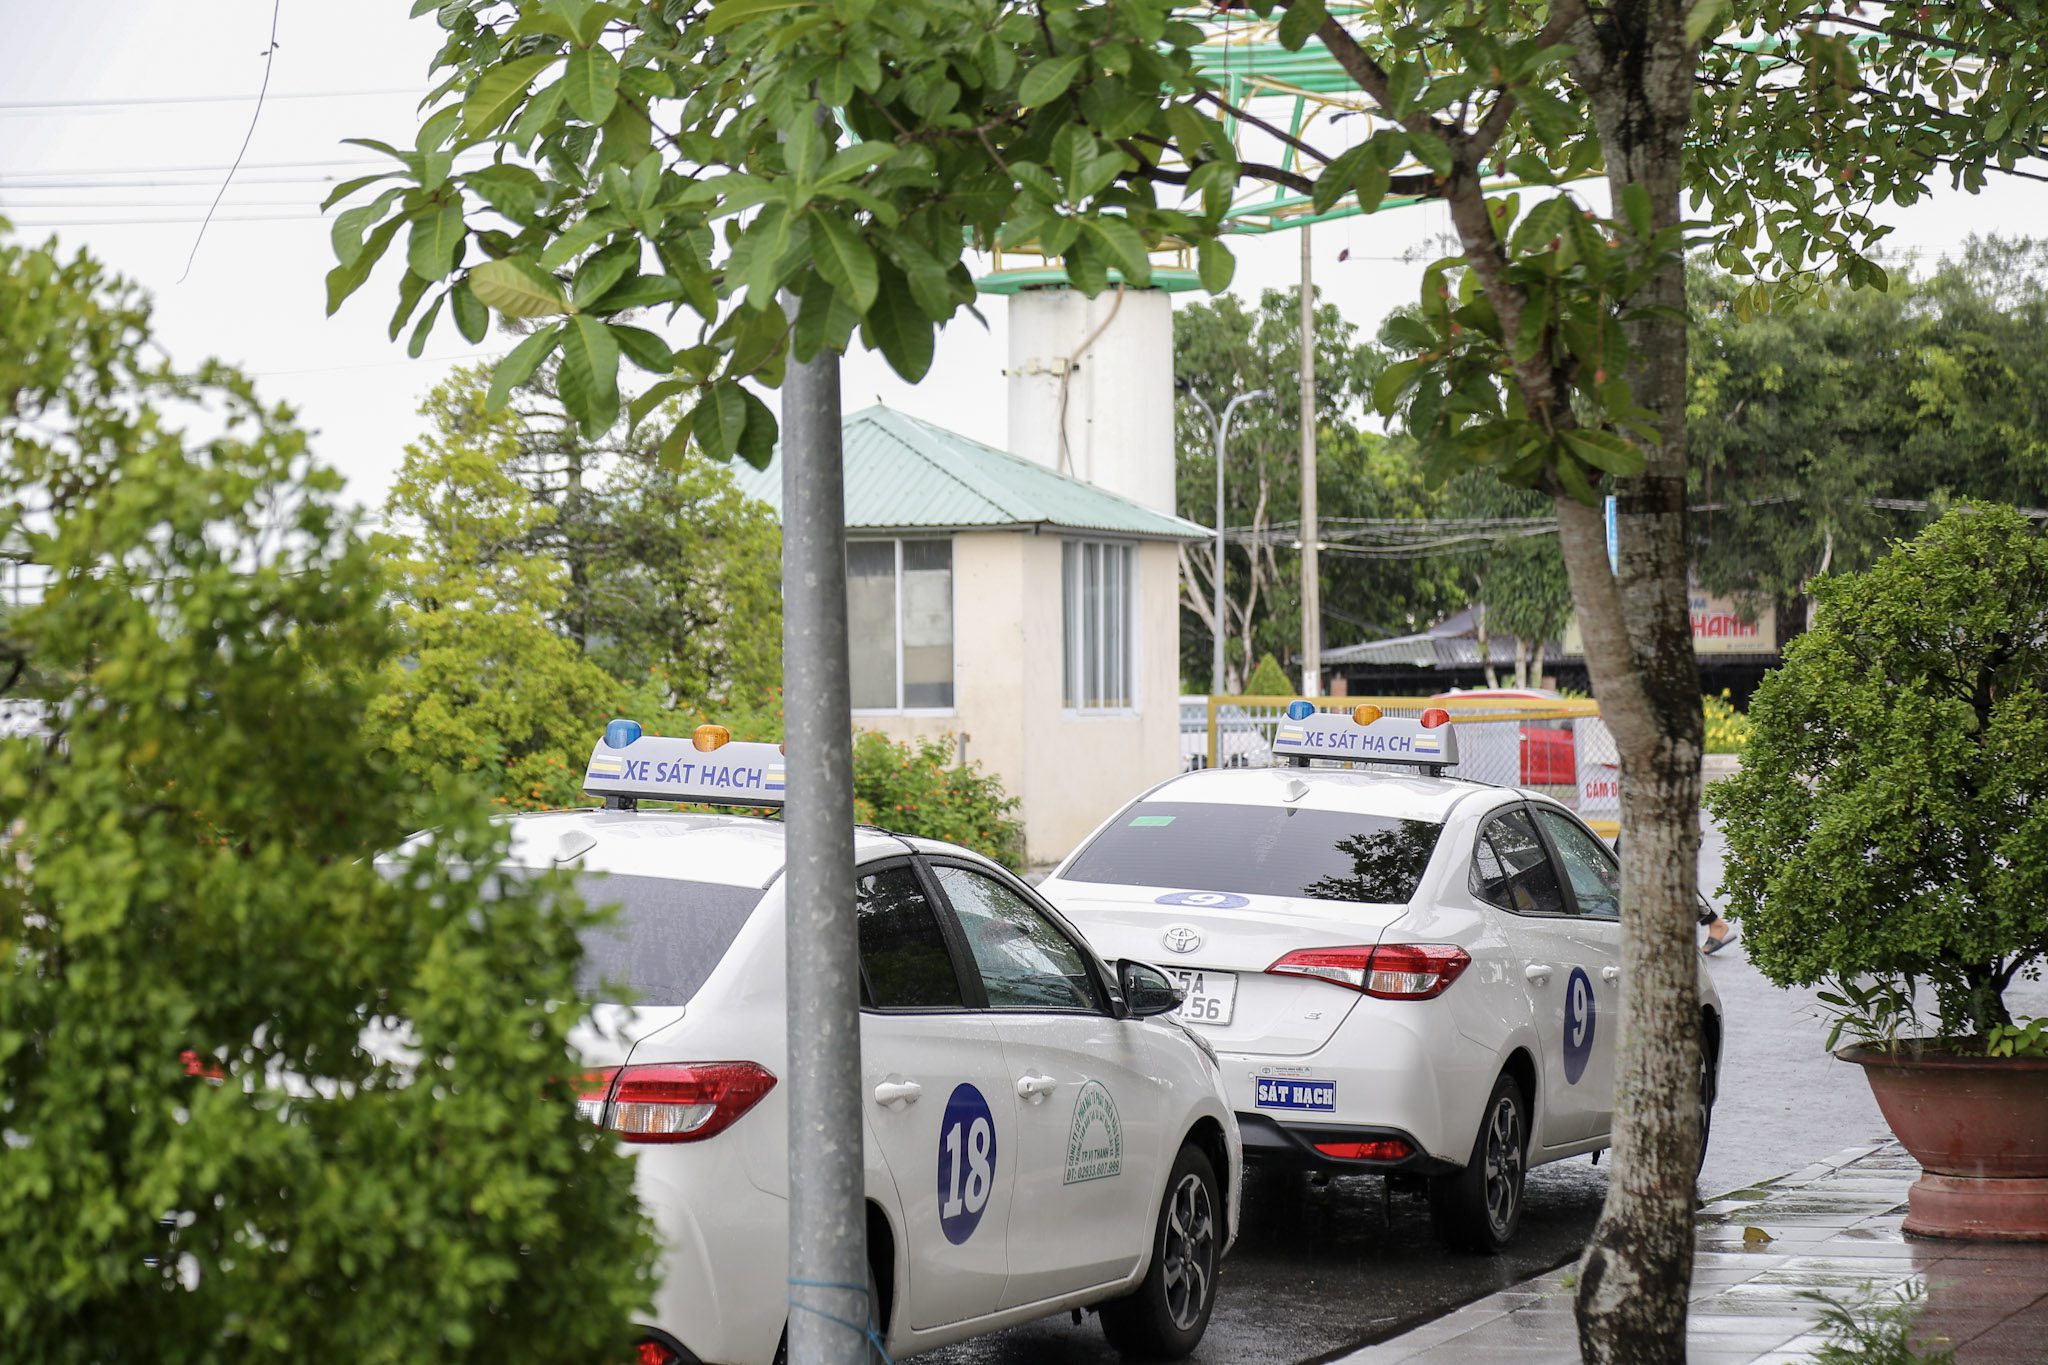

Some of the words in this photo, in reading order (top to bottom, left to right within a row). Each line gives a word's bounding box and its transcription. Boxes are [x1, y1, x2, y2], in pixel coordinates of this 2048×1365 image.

[1304, 731, 1324, 747] XE
[1328, 730, 1358, 749] SÁT
[1362, 735, 1411, 753] HẠCH
[623, 759, 650, 781] XE
[655, 758, 695, 784] SÁT
[700, 765, 762, 789] HẠCH
[1180, 893, 1226, 906] 9
[1168, 970, 1204, 994] 5A
[1573, 977, 1588, 1048] 9
[1258, 1080, 1289, 1103] SÁT
[1293, 1086, 1333, 1108] HẠCH
[943, 1116, 991, 1219] 18
